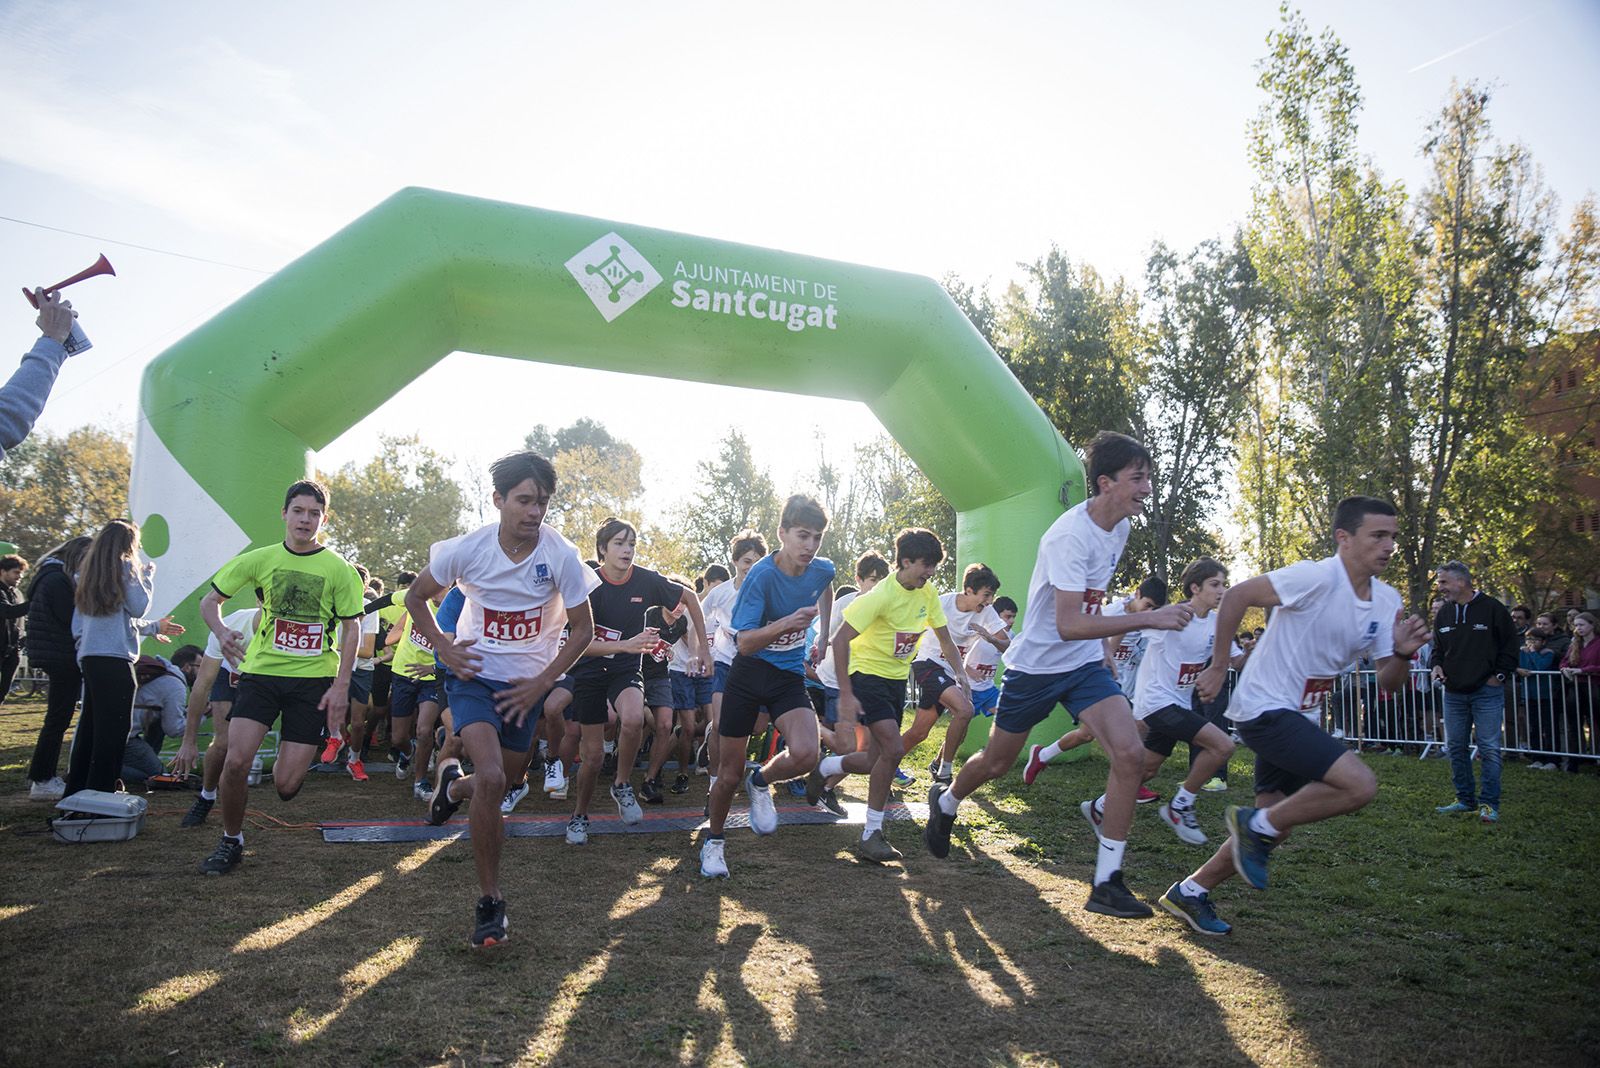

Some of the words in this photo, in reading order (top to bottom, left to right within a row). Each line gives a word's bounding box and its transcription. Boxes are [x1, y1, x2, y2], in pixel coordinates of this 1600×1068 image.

[673, 261, 808, 297] AJUNTAMENT
[814, 282, 838, 301] DE
[671, 280, 838, 331] SantCugat
[277, 631, 320, 649] 4567
[486, 620, 539, 640] 4101
[772, 629, 805, 645] 594
